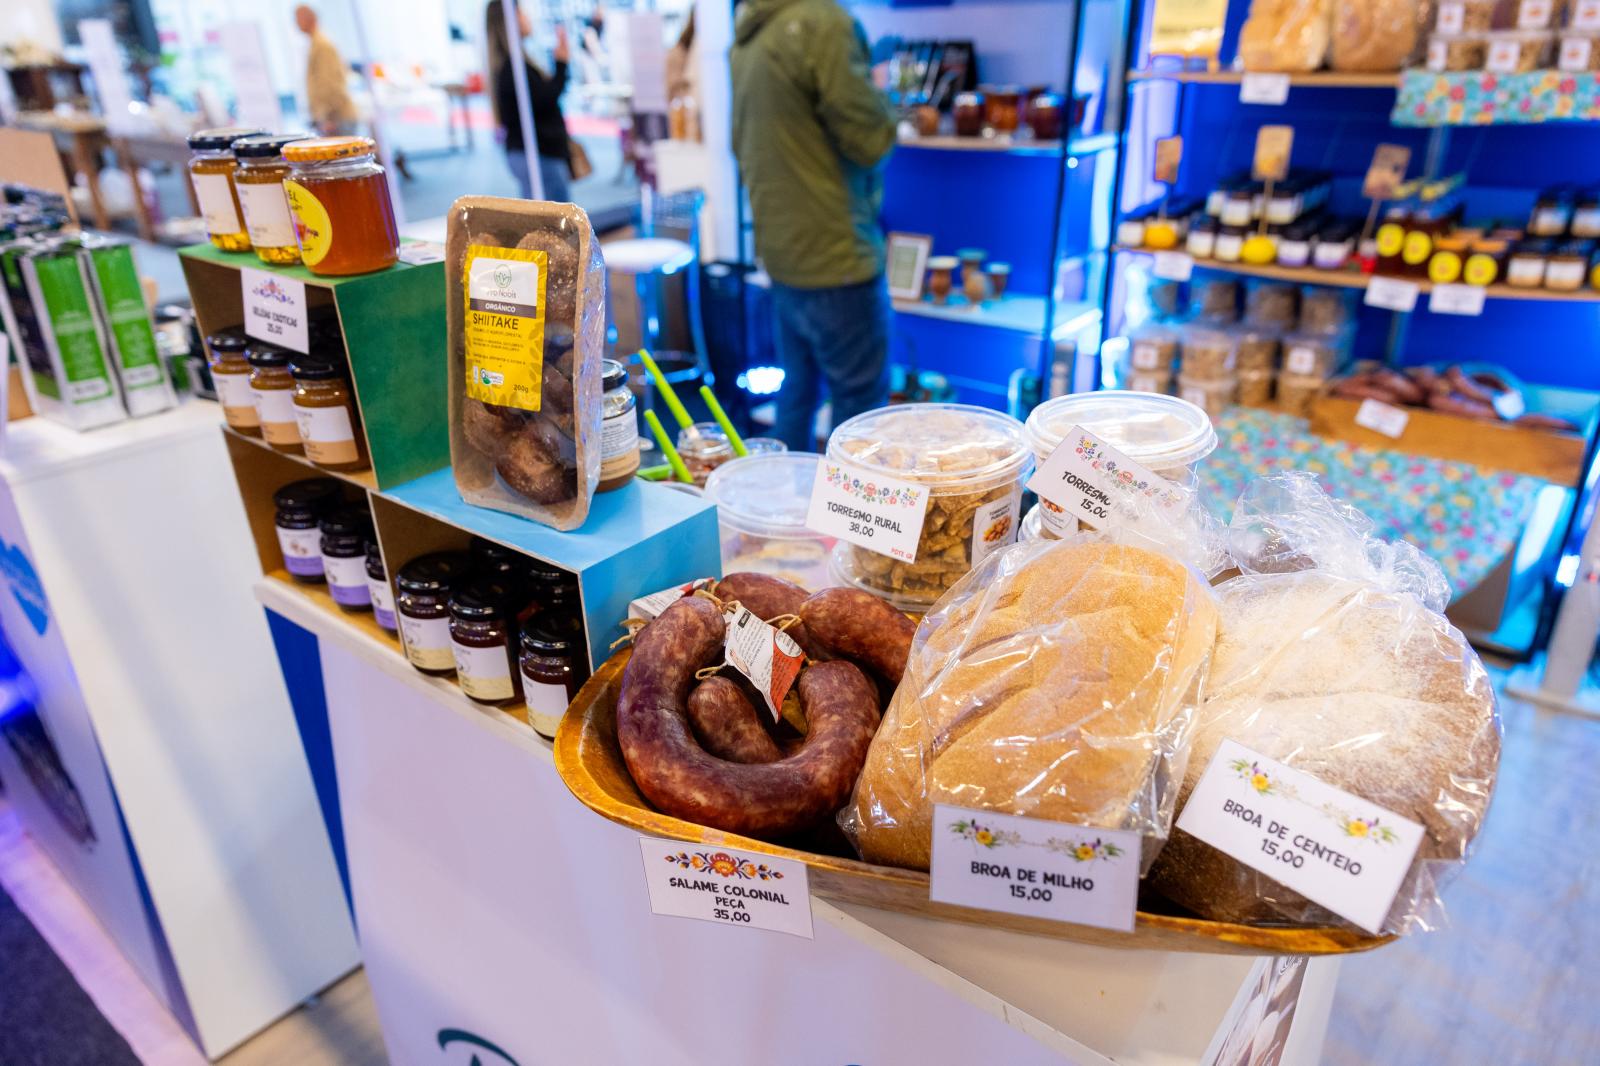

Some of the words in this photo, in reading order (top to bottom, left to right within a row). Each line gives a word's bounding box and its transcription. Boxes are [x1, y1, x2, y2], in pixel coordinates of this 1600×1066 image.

[485, 302, 516, 313] ORGÂNICO
[472, 313, 520, 330] SHIITAKE
[513, 384, 529, 393] 200g
[827, 501, 872, 523] TORRESMO
[874, 515, 902, 533] RURAL
[1080, 498, 1107, 519] 15,00
[849, 521, 874, 537] 38,00
[1223, 799, 1262, 828] BROA
[1267, 820, 1290, 840] DE
[1293, 834, 1362, 876] CENTEIO
[1261, 838, 1305, 869] 15,00
[971, 861, 1011, 879] BROA
[1017, 868, 1037, 883] DE
[1043, 871, 1094, 891] MILHO
[669, 877, 719, 893] SALAME
[724, 885, 790, 905] COLONIAL
[1010, 884, 1053, 902] 15,00
[715, 896, 745, 909] PEÇA
[713, 908, 751, 923] 35,00
